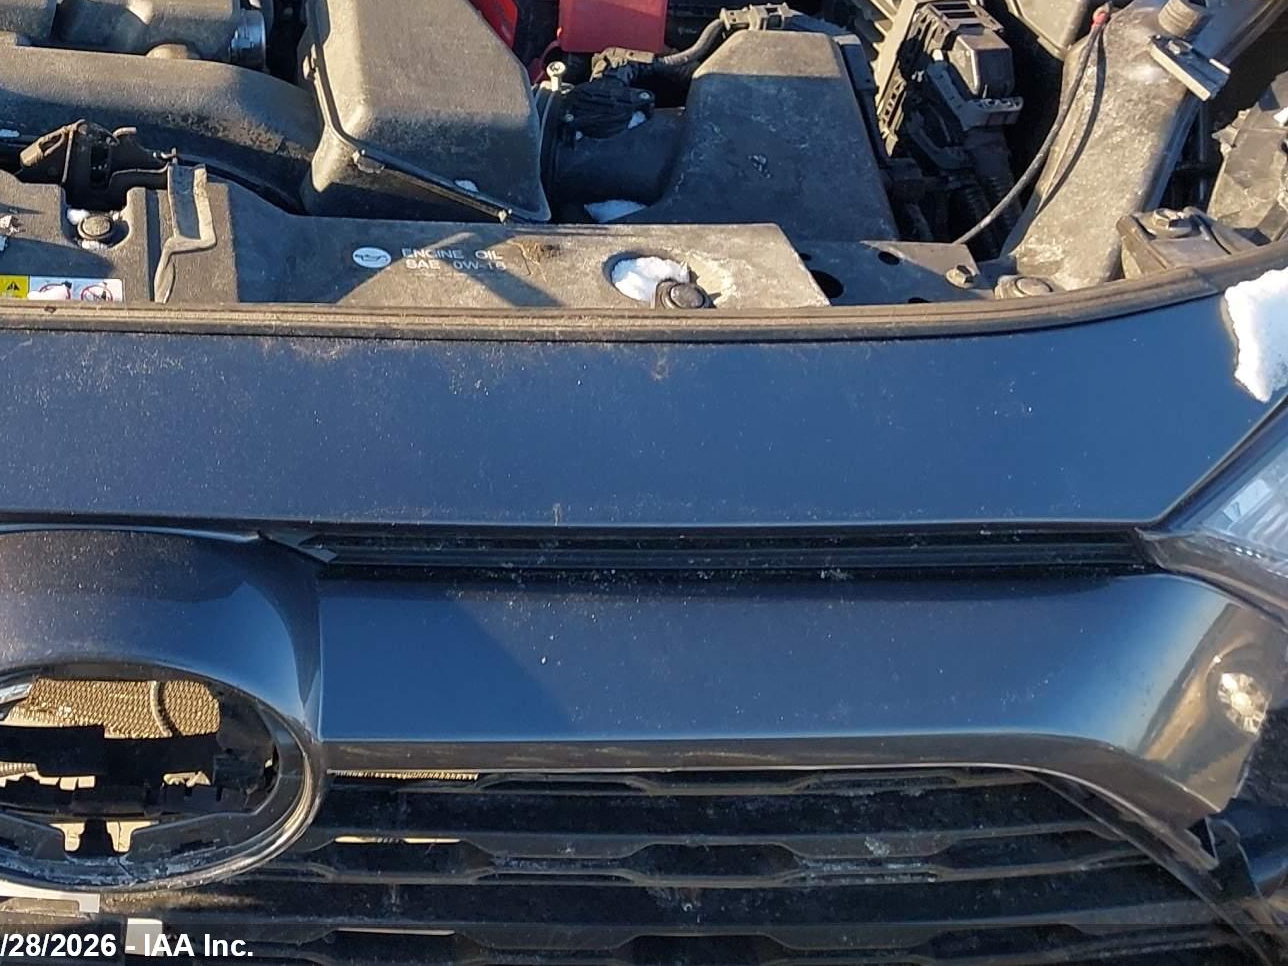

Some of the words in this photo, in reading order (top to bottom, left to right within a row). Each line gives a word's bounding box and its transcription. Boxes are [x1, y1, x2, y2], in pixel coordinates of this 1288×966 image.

[401, 247, 464, 260] ENGINE
[474, 249, 504, 261] OIL
[405, 258, 441, 270] SAE
